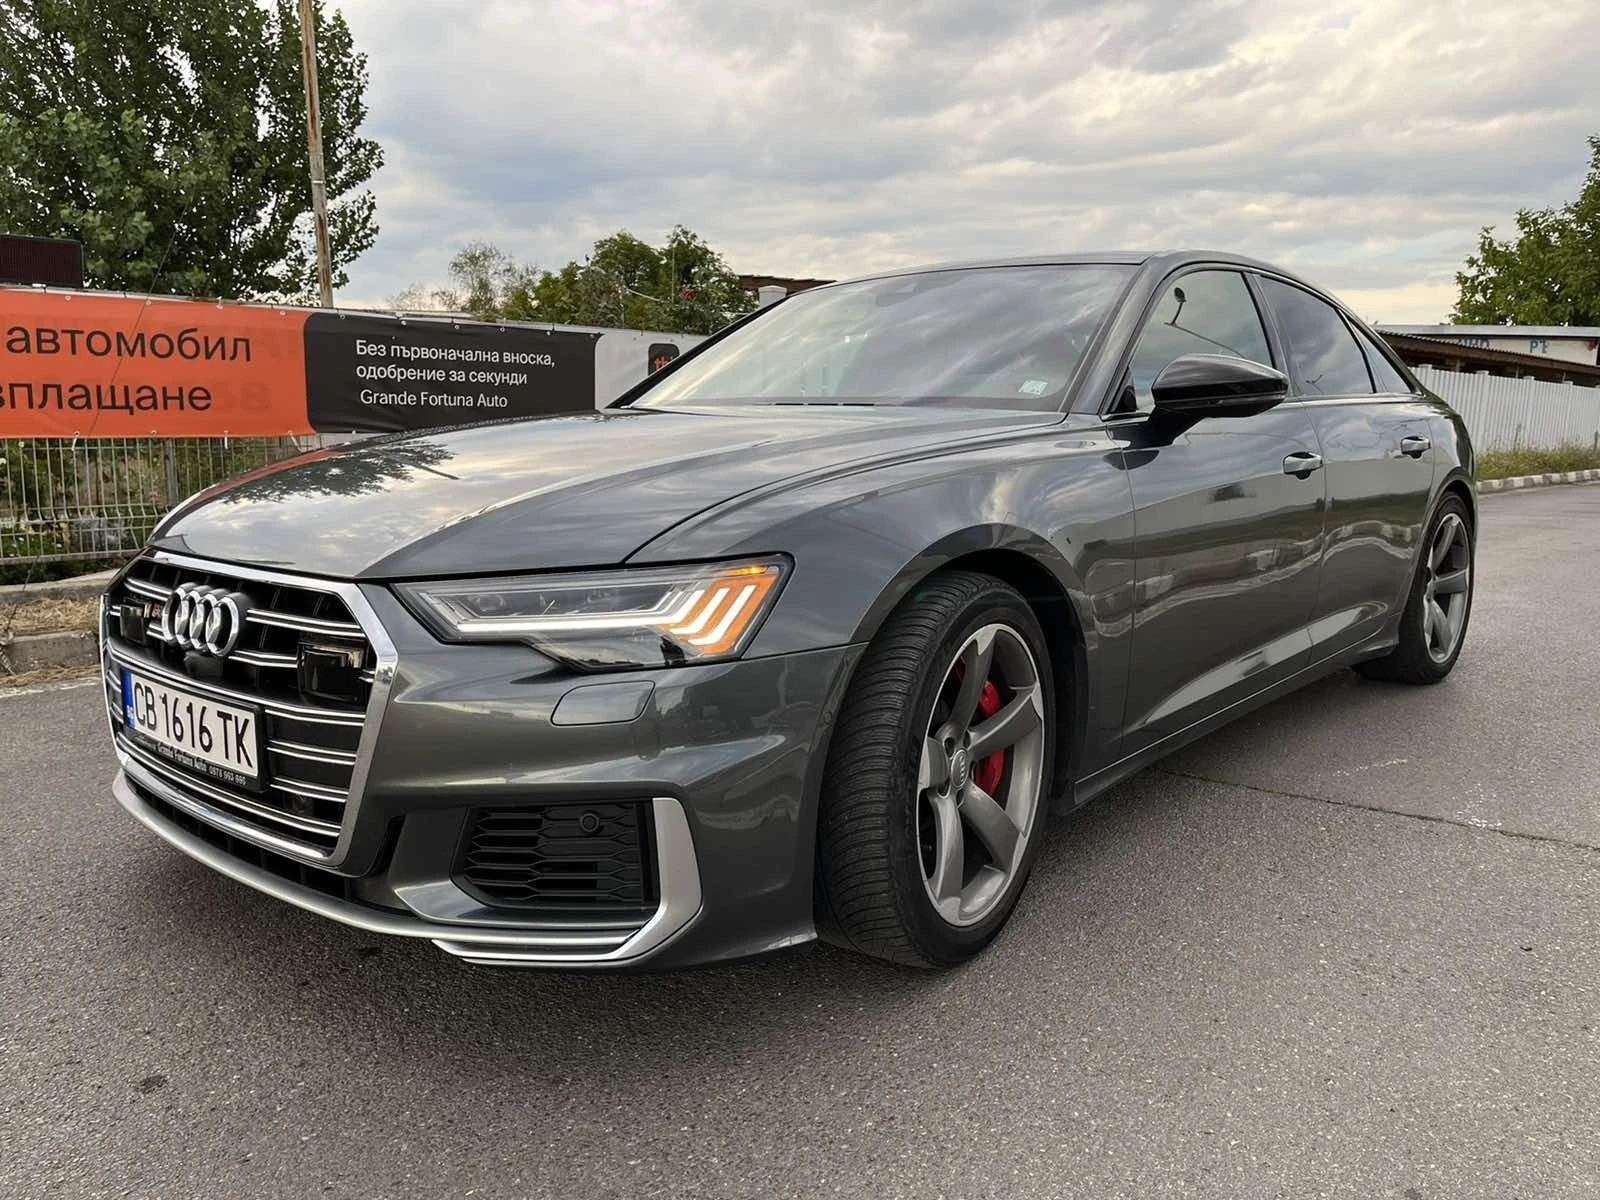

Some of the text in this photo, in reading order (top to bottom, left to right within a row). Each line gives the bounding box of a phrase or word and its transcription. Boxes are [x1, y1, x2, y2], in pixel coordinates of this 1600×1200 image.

[6, 325, 251, 362] автомобил
[356, 339, 556, 368] Без първоначална вноска,
[356, 364, 528, 386] одобрение за секунди
[0, 381, 213, 416] плащане
[360, 389, 508, 408] Grande Fortuna Auto
